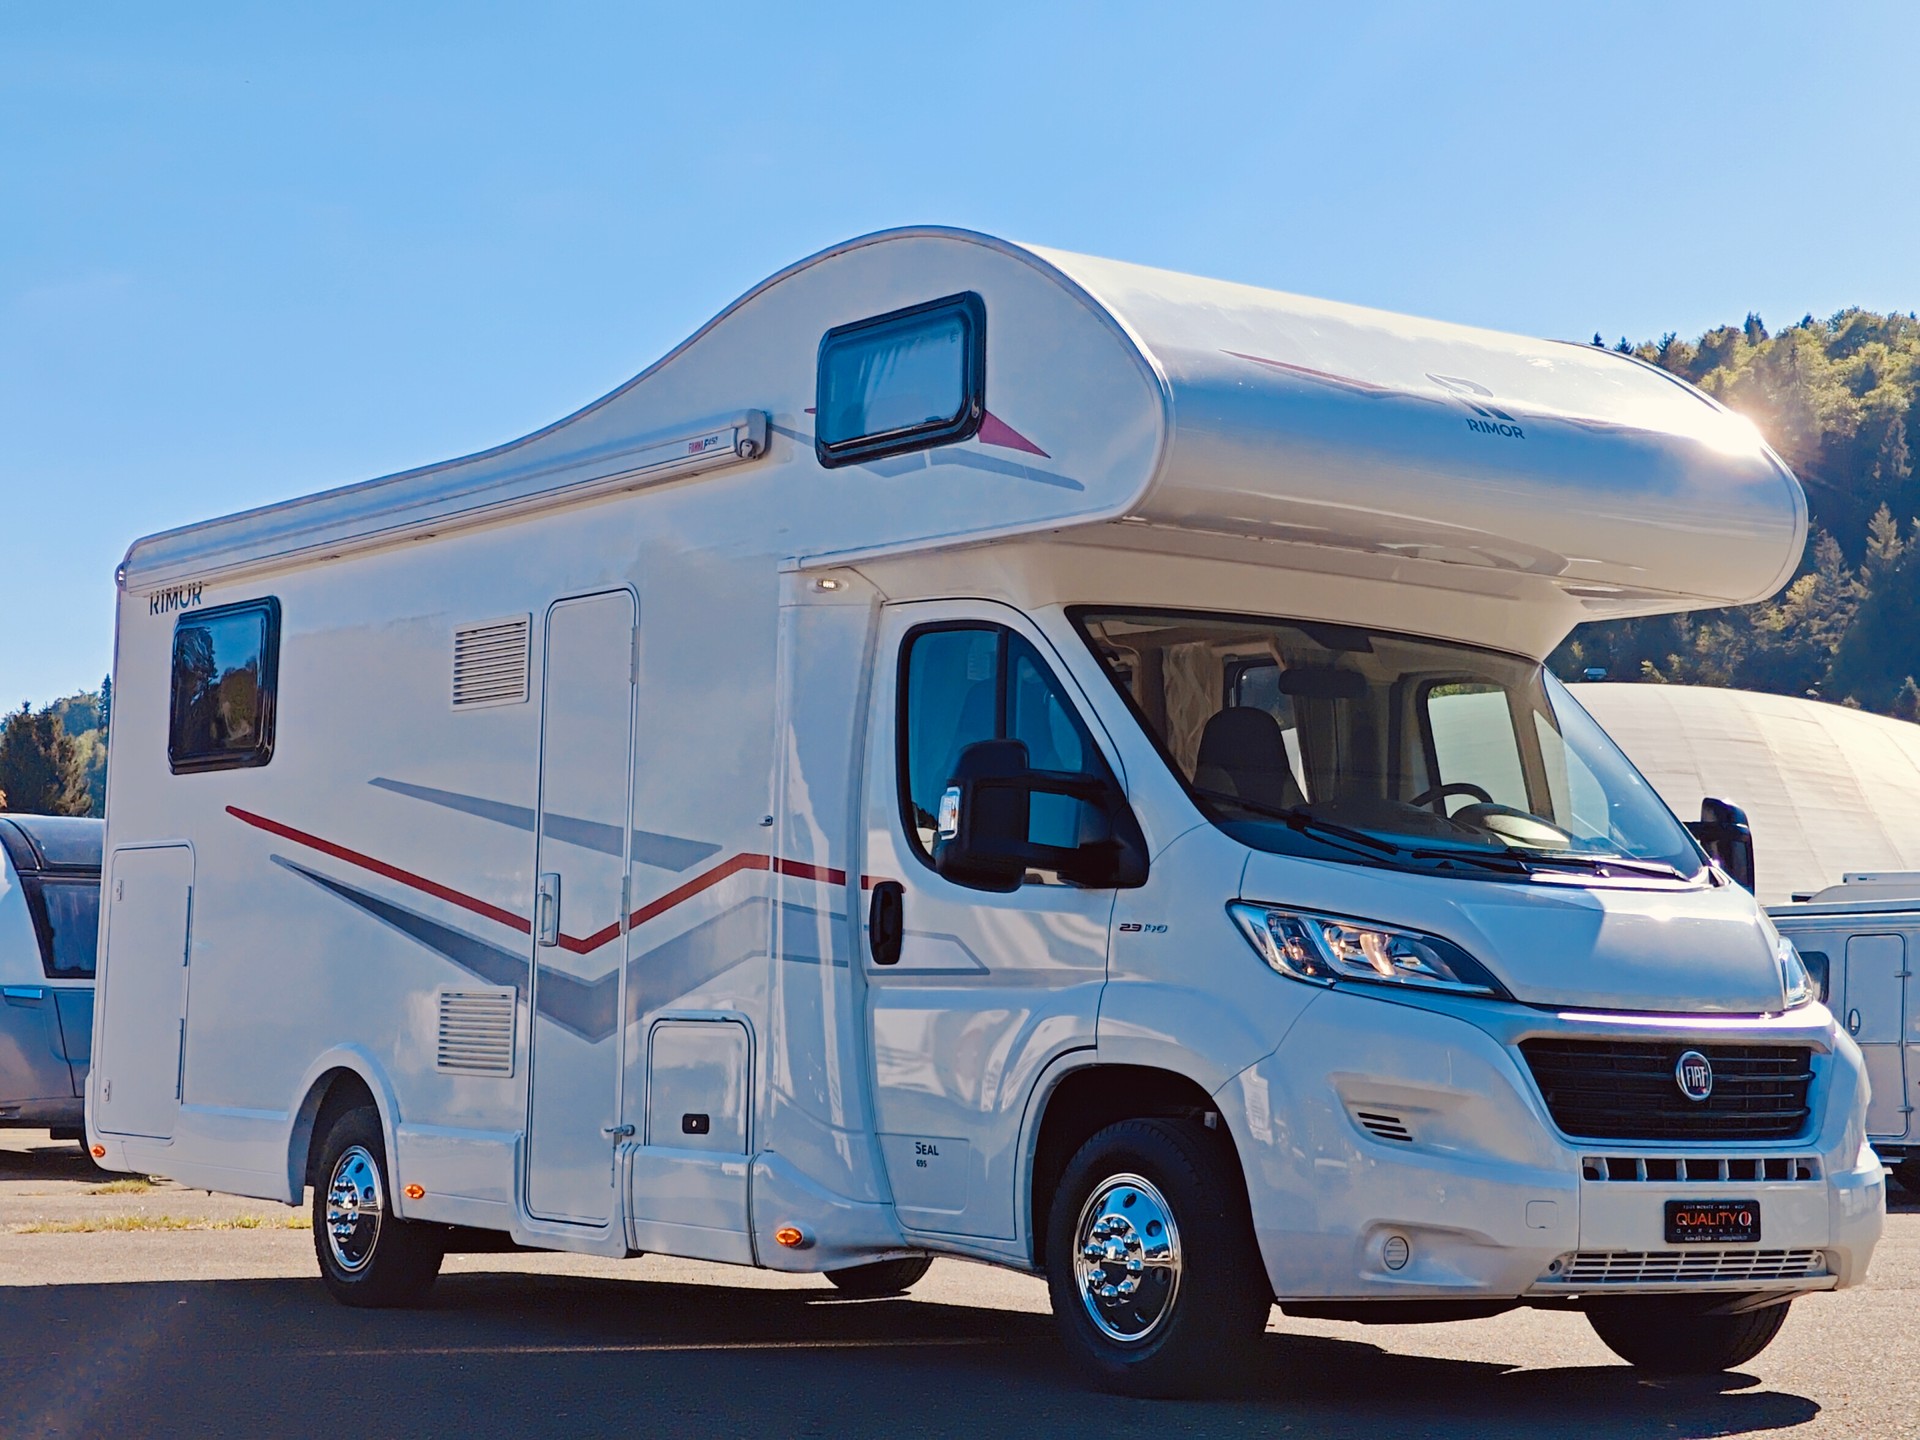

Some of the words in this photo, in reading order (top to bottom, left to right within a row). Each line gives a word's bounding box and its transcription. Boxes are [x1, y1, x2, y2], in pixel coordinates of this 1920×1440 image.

[1465, 418, 1526, 440] RIMOR
[1685, 1066, 1706, 1087] FIAT
[915, 1141, 940, 1156] SEAL
[1676, 1211, 1738, 1226] QUALITY
